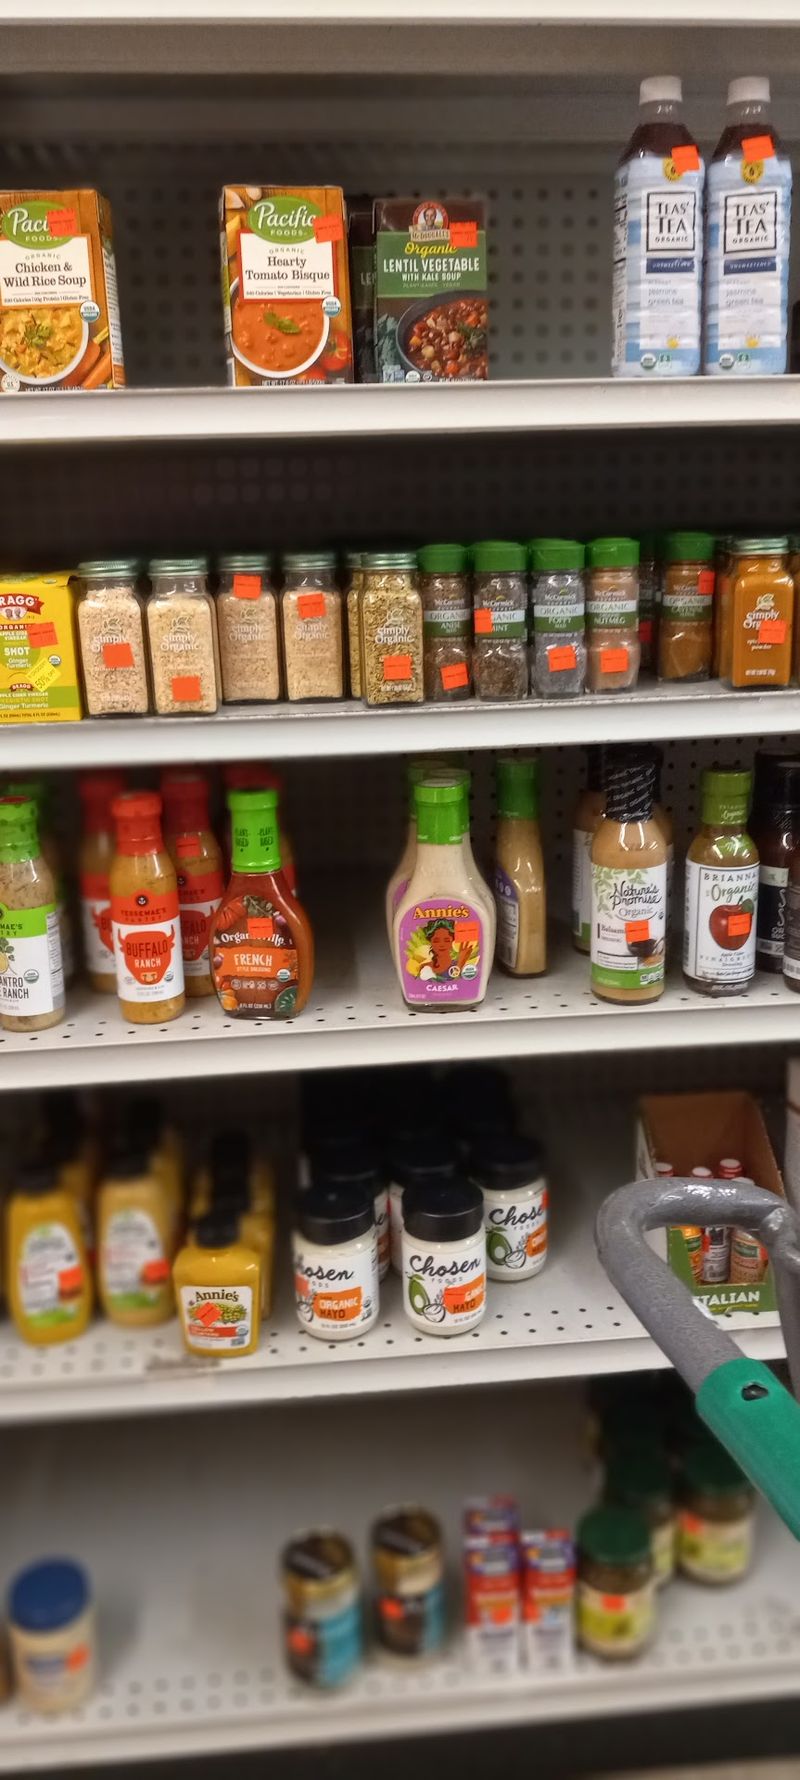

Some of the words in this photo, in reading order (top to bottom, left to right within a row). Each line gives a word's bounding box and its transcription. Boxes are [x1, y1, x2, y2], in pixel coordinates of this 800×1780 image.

[254, 201, 316, 229] Pacific
[7, 207, 49, 236] Paci
[655, 216, 687, 234] TEA
[733, 217, 766, 235] TEA
[655, 235, 689, 243] ORGANIC
[732, 235, 769, 245] ORGANIC
[269, 246, 305, 254] ORGANIC
[404, 242, 457, 259] Organic
[25, 252, 61, 261] ORGANIC
[267, 256, 307, 269] Hearty
[15, 261, 61, 274] Chicken
[63, 261, 73, 272] &
[383, 258, 418, 272] LENTIL
[421, 257, 480, 272] VEGETABLE
[3, 276, 29, 288] Wild
[31, 275, 57, 287] Rice
[58, 274, 87, 288] Soup
[245, 269, 288, 281] Tomato
[292, 269, 330, 282] Bisque
[402, 273, 419, 281] WITH
[422, 273, 439, 281] KALE
[442, 272, 462, 280] SOUP
[0, 595, 35, 607] RAGG
[591, 603, 629, 611] ORGANIC
[541, 606, 578, 616] ORGANIC
[746, 609, 780, 621] simply
[377, 624, 410, 636] simply
[162, 633, 196, 643] simply
[374, 634, 415, 644] Organic
[4, 647, 29, 656] SHOT
[160, 641, 198, 652] Organic
[610, 880, 661, 899] Nature's
[611, 894, 663, 911] Promise
[413, 904, 470, 919] Annie's
[618, 906, 654, 918] Organic
[126, 940, 169, 958] BUFFALO
[134, 958, 162, 969] RANCH
[233, 953, 273, 966] FRENCH
[0, 976, 24, 987] ANTRO
[3, 988, 29, 999] RANCH
[426, 984, 459, 992] CAESAR
[409, 1254, 481, 1277] Chosen
[195, 1289, 240, 1303] Annie's
[319, 1297, 358, 1309] ORGANIC
[453, 1298, 476, 1314] MAYO
[320, 1309, 346, 1319] MAYO
